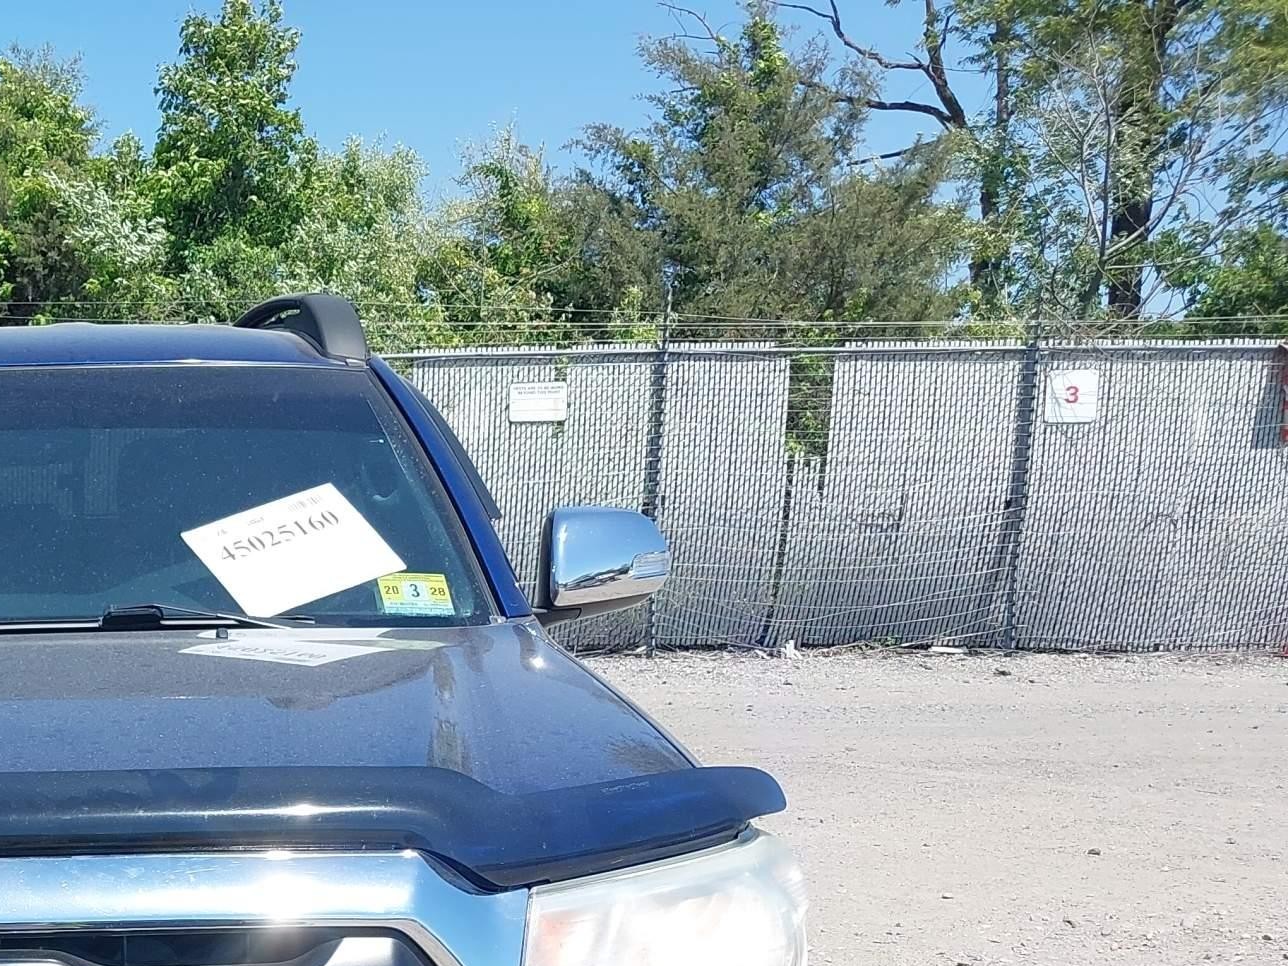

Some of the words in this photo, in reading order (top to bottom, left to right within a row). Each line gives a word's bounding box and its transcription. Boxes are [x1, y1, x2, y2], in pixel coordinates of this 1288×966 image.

[1064, 385, 1079, 404] 3
[220, 510, 339, 561] 45025160
[384, 585, 400, 595] 20
[409, 583, 420, 598] 3
[429, 586, 446, 596] 28
